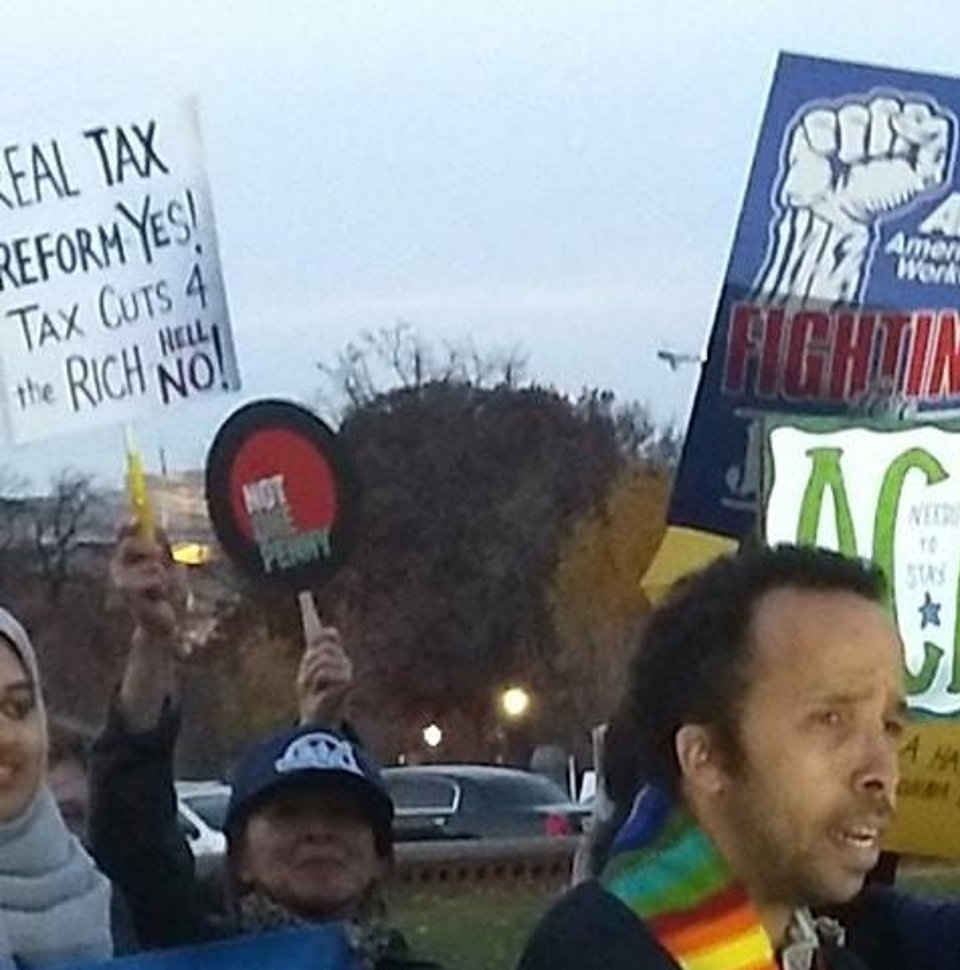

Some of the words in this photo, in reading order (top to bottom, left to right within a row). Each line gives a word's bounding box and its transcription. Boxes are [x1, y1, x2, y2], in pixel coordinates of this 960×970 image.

[84, 119, 169, 187] TAX
[0, 221, 127, 292] REFORM
[115, 188, 202, 264] YES!
[185, 263, 207, 310] 4
[159, 319, 209, 356] HELL
[17, 376, 57, 410] the
[66, 345, 147, 412] RICH
[156, 323, 230, 405] NO!
[241, 473, 287, 515] NOT
